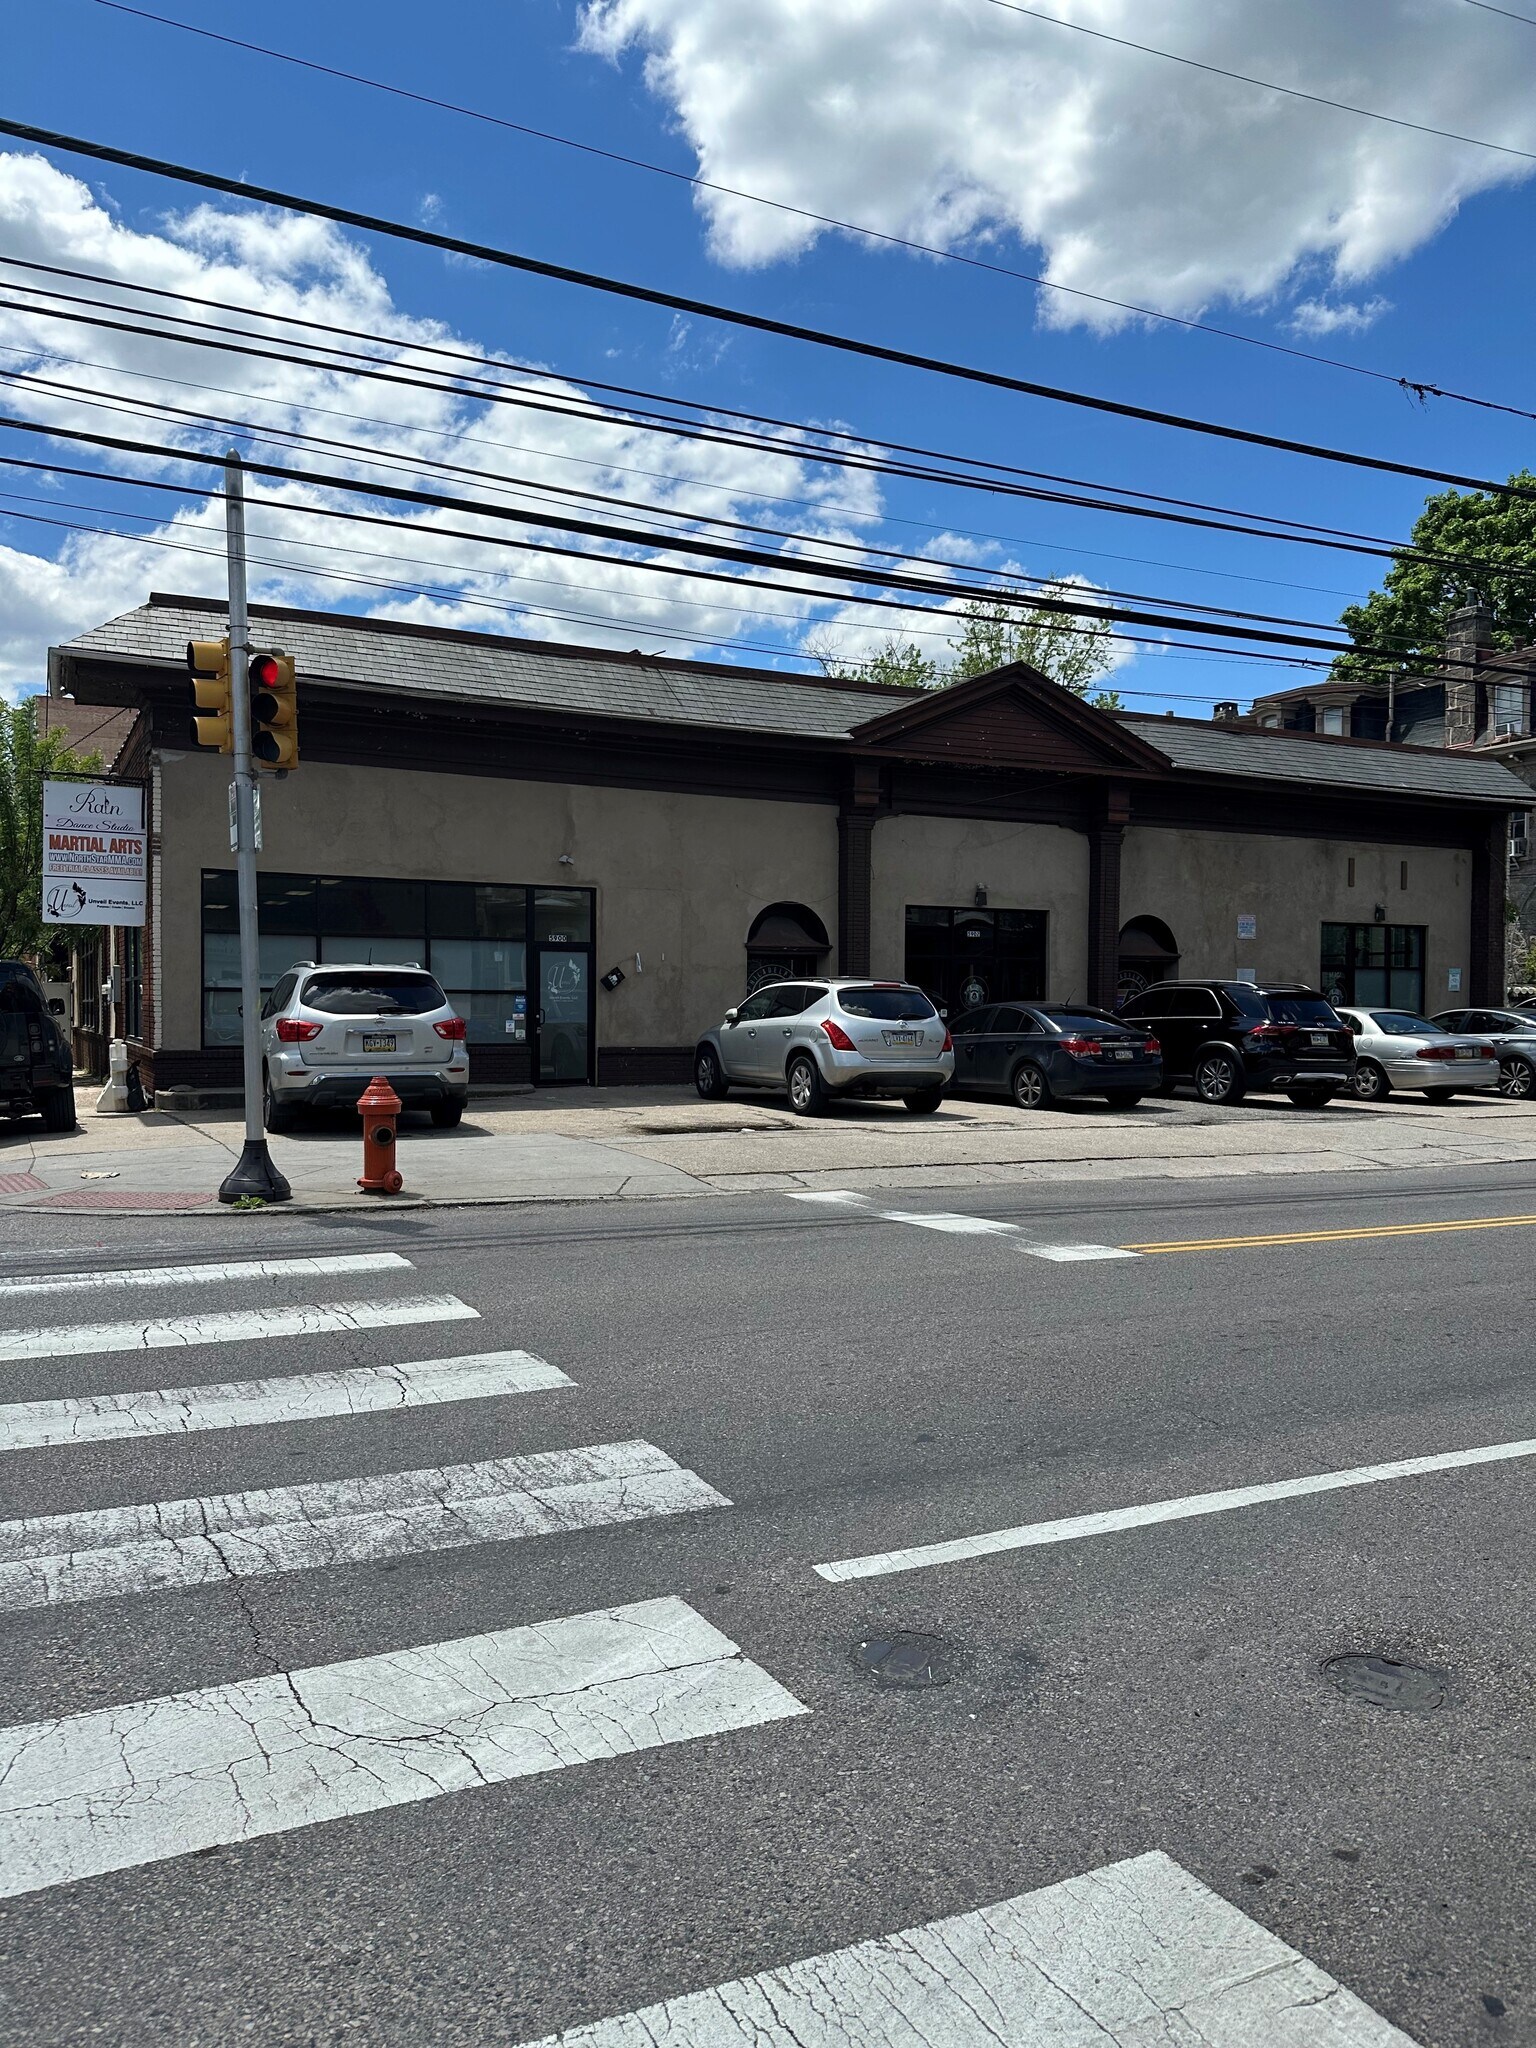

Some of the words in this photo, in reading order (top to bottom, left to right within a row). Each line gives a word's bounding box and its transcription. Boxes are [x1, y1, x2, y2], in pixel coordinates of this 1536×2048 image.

[69, 787, 123, 816] Rain
[56, 818, 93, 829] Dance
[96, 820, 135, 832] Studio
[49, 834, 107, 853] MARTIAL
[109, 838, 143, 854] ARTS
[49, 863, 64, 872] FREE
[65, 864, 82, 874] TRIAL
[83, 865, 109, 875] CLASSES
[110, 866, 143, 876] AVAILABLE!
[548, 934, 567, 942] 5900
